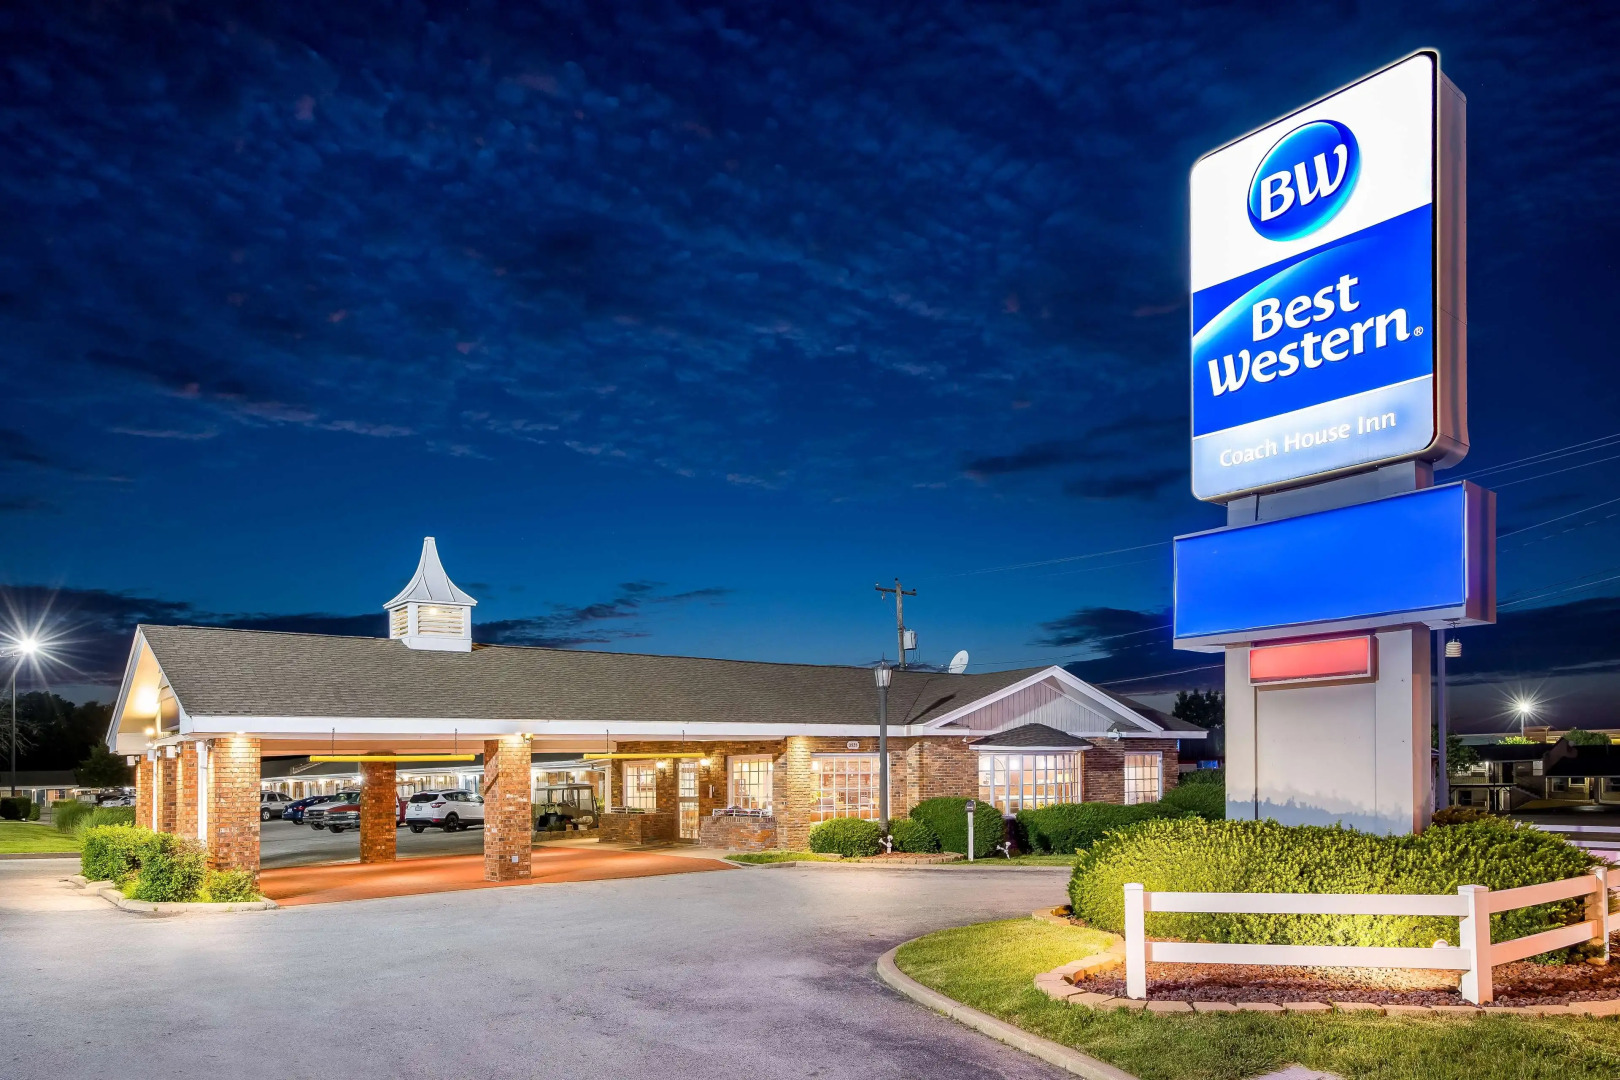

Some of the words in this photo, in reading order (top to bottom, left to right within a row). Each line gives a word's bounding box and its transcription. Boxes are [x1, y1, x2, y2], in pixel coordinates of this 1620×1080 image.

[1260, 143, 1347, 222] BW
[1252, 274, 1360, 342] Best
[1219, 439, 1278, 467] Coach
[1284, 423, 1351, 452] House
[1356, 412, 1397, 435] Inn
